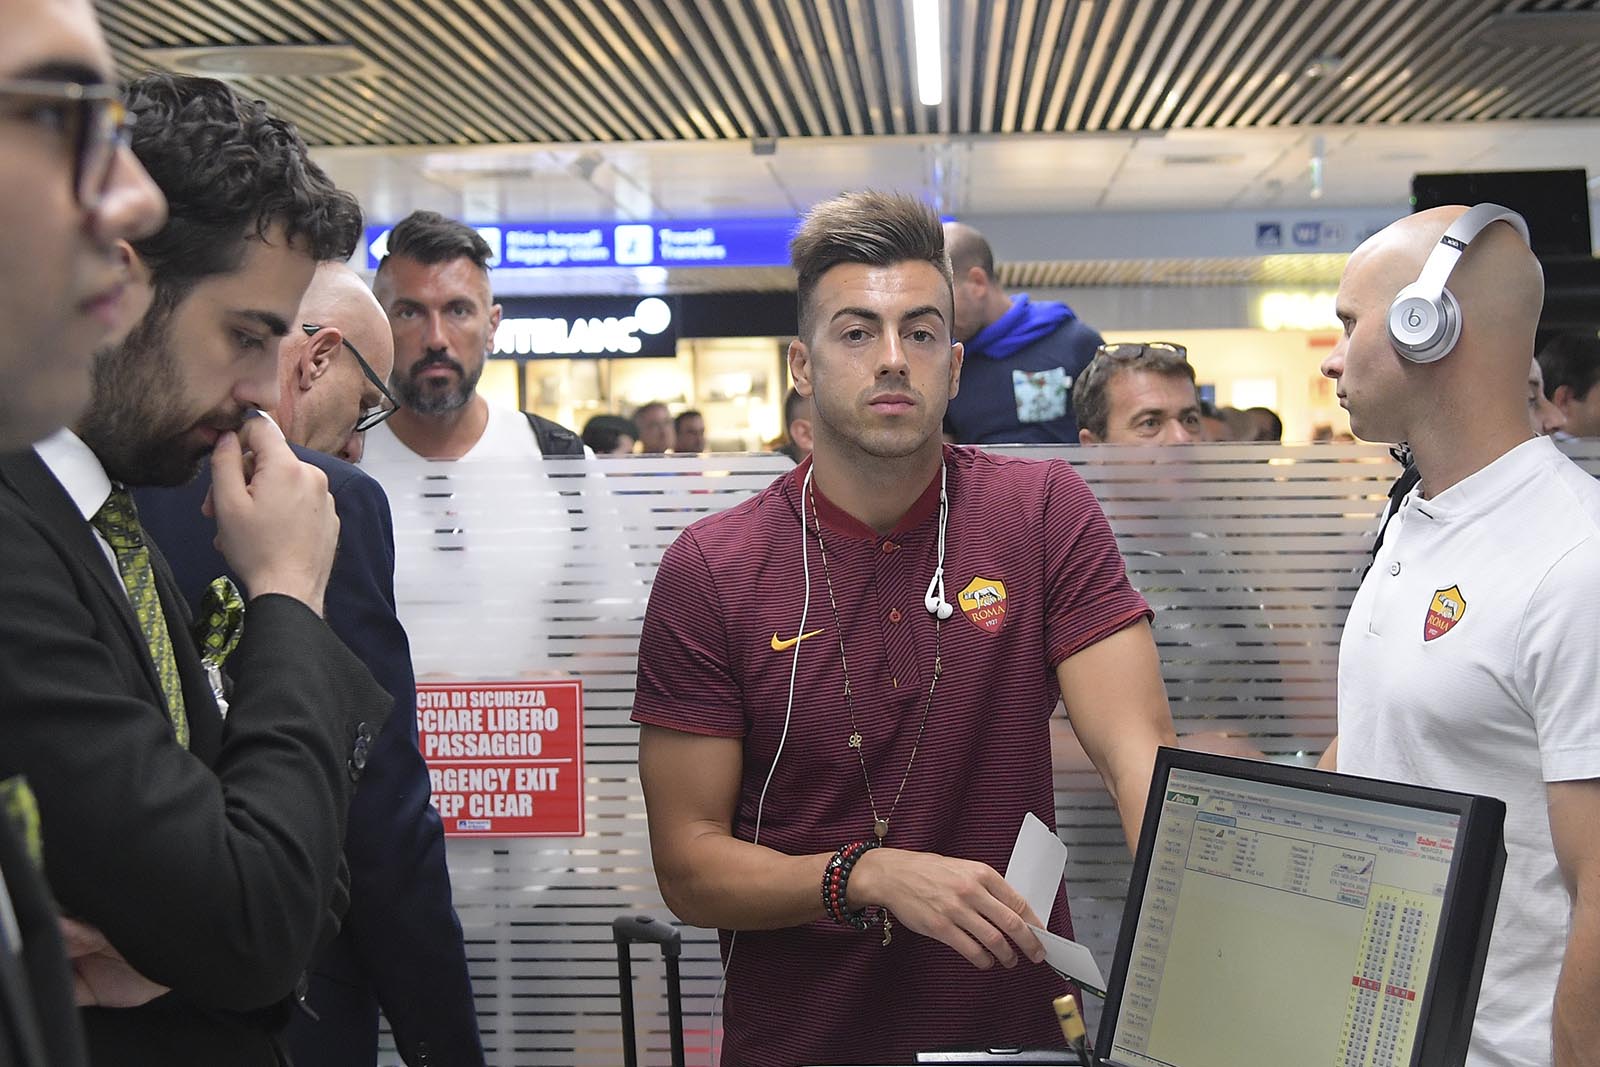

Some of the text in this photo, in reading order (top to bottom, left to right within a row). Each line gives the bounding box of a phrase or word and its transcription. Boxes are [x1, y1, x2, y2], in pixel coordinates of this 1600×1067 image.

[972, 606, 1005, 622] ROMA
[1427, 615, 1449, 631] ROMA
[452, 692, 466, 707] DI
[470, 691, 546, 707] SICUREZZA
[487, 708, 559, 731] LIBERO
[425, 733, 542, 756] PASSAGGIO
[515, 768, 559, 791] EXIT
[469, 794, 533, 817] CLEAR
